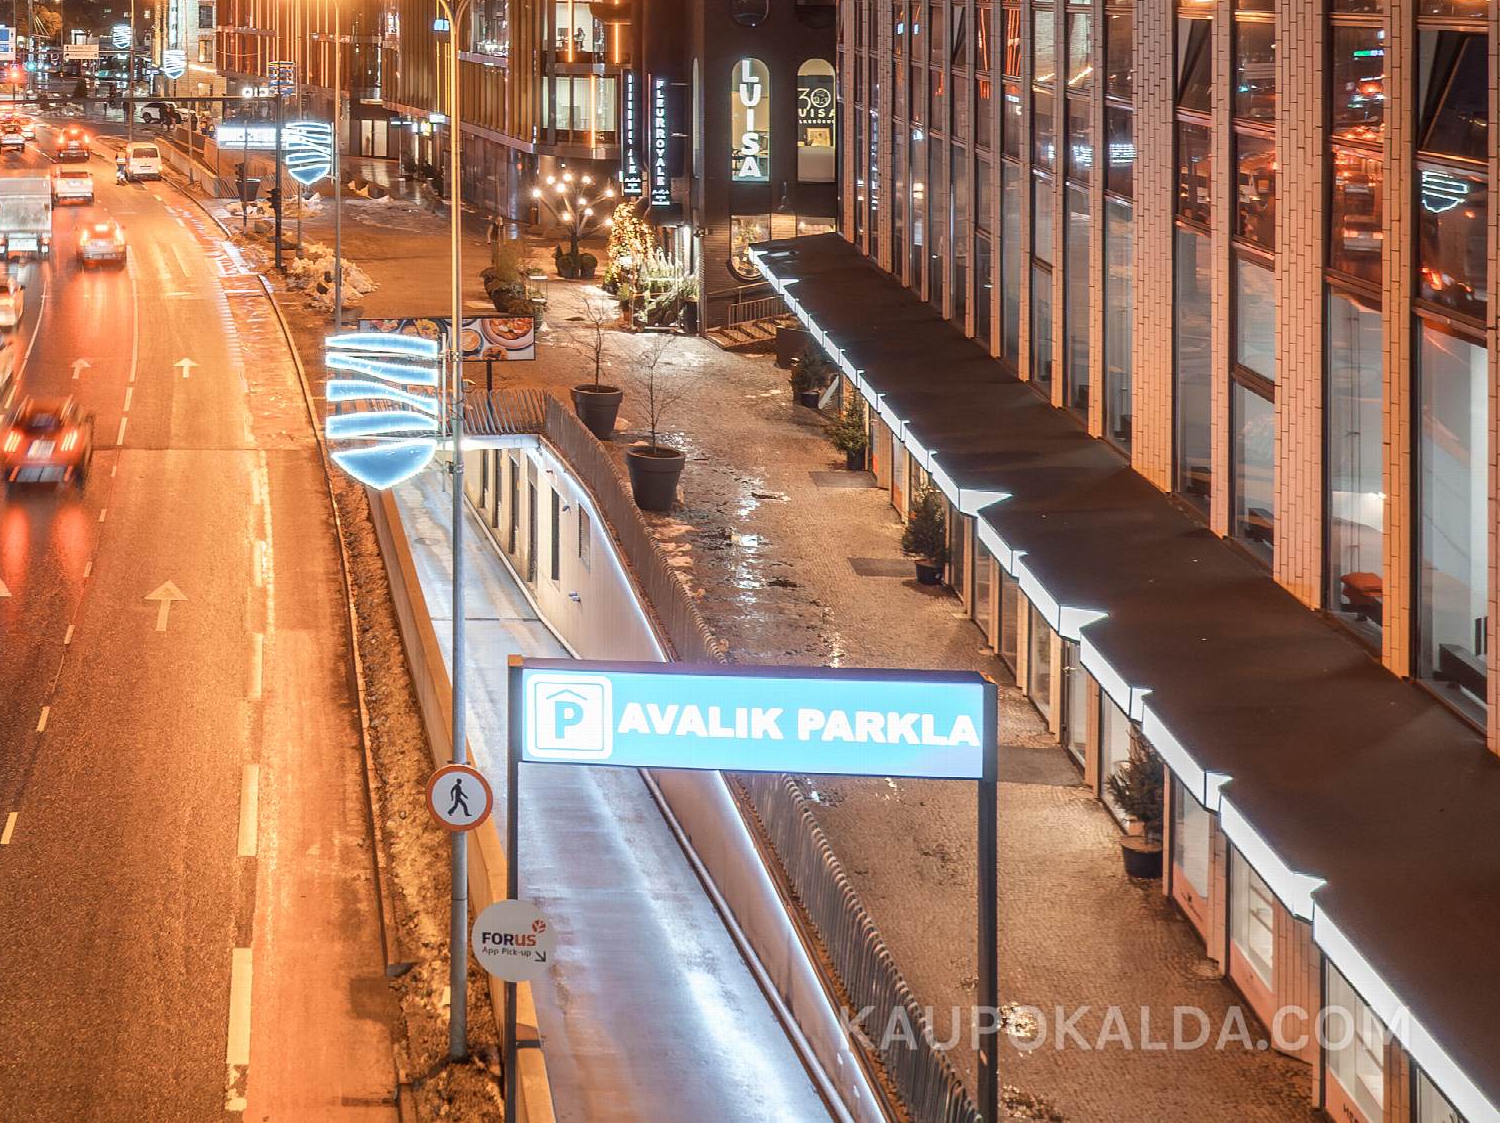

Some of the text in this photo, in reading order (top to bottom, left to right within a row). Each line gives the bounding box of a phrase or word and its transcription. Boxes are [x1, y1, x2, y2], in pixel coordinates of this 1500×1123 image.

[739, 59, 762, 177] LUISA
[798, 108, 836, 118] UISA
[554, 699, 585, 740] P
[617, 702, 981, 747] AVALIK PARKLA
[482, 931, 537, 947] FORUS
[482, 946, 532, 958] App Pick-up
